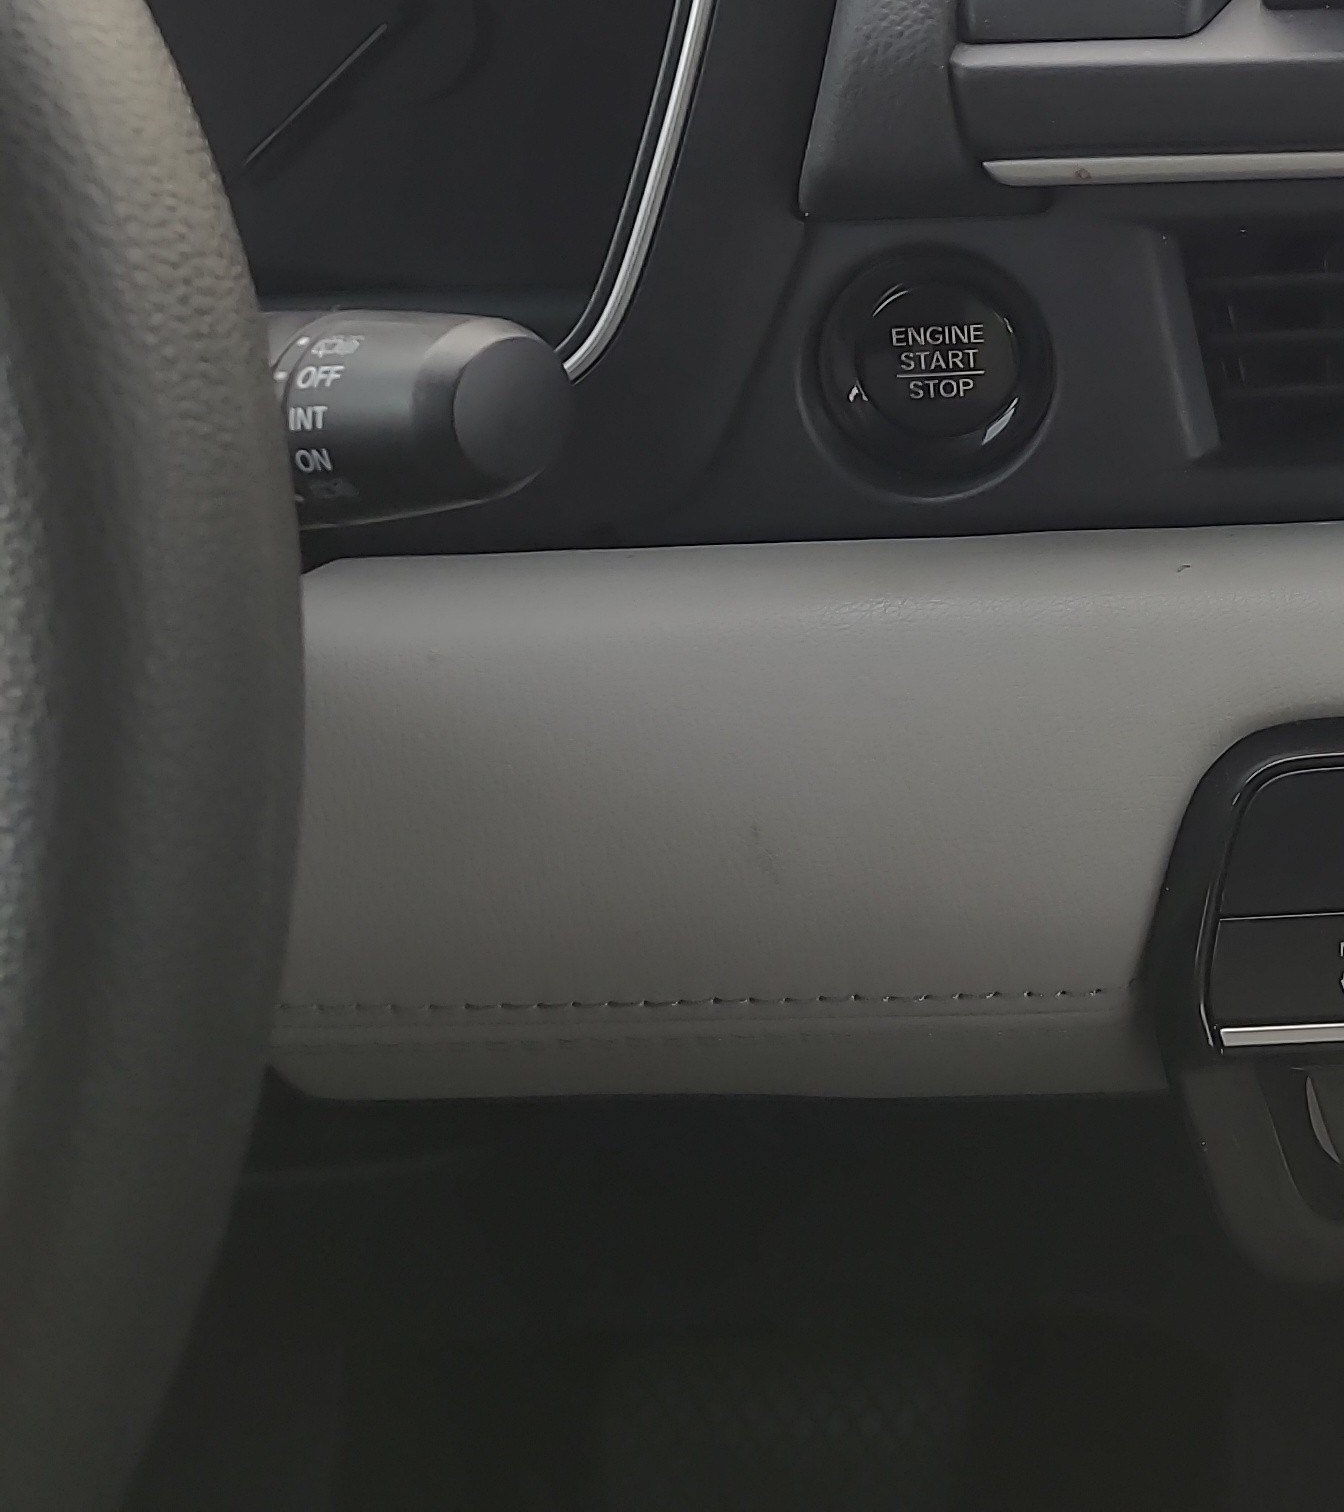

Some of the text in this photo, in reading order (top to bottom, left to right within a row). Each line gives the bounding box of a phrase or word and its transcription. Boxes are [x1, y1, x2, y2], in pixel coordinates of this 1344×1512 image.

[891, 324, 985, 347] ENGINE
[900, 349, 979, 369] START
[296, 365, 346, 389] OFF
[908, 379, 974, 400] STOP
[288, 405, 329, 431] INT
[295, 448, 332, 472] ON
